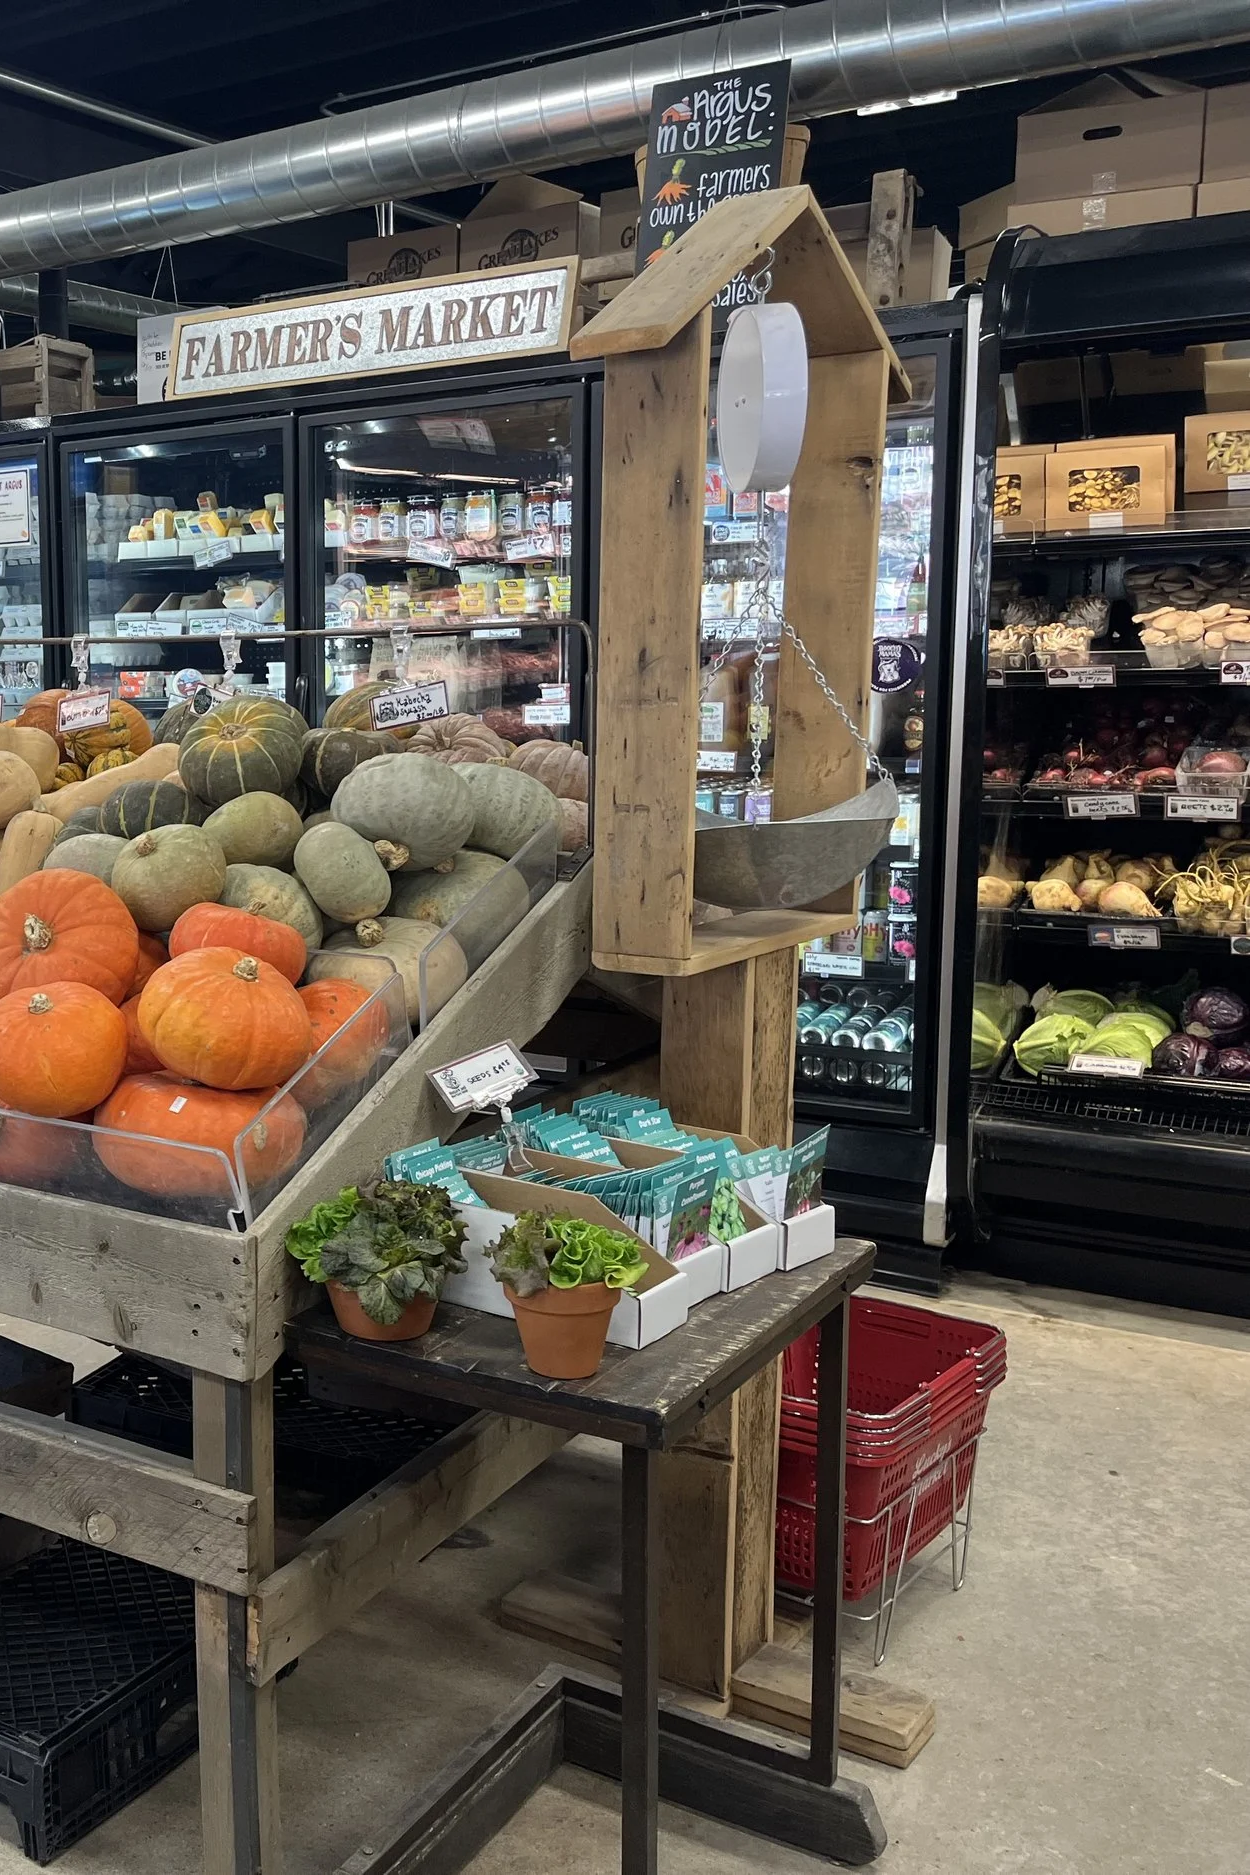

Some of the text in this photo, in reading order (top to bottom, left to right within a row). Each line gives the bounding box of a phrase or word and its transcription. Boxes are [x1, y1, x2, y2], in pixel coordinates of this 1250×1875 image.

[714, 77, 742, 91] THE
[697, 164, 770, 197] farmers
[650, 202, 684, 227] own
[182, 311, 363, 381] FARMER'S
[375, 285, 558, 355] MARKET
[155, 351, 166, 361] BE
[5, 480, 22, 490] ARGUS
[396, 693, 432, 707] Kabocha
[467, 1071, 491, 1084] SEEDS
[415, 1160, 454, 1180] Chicago Pickling
[688, 1178, 706, 1191] Purple
[681, 1189, 708, 1207] Coneflower
